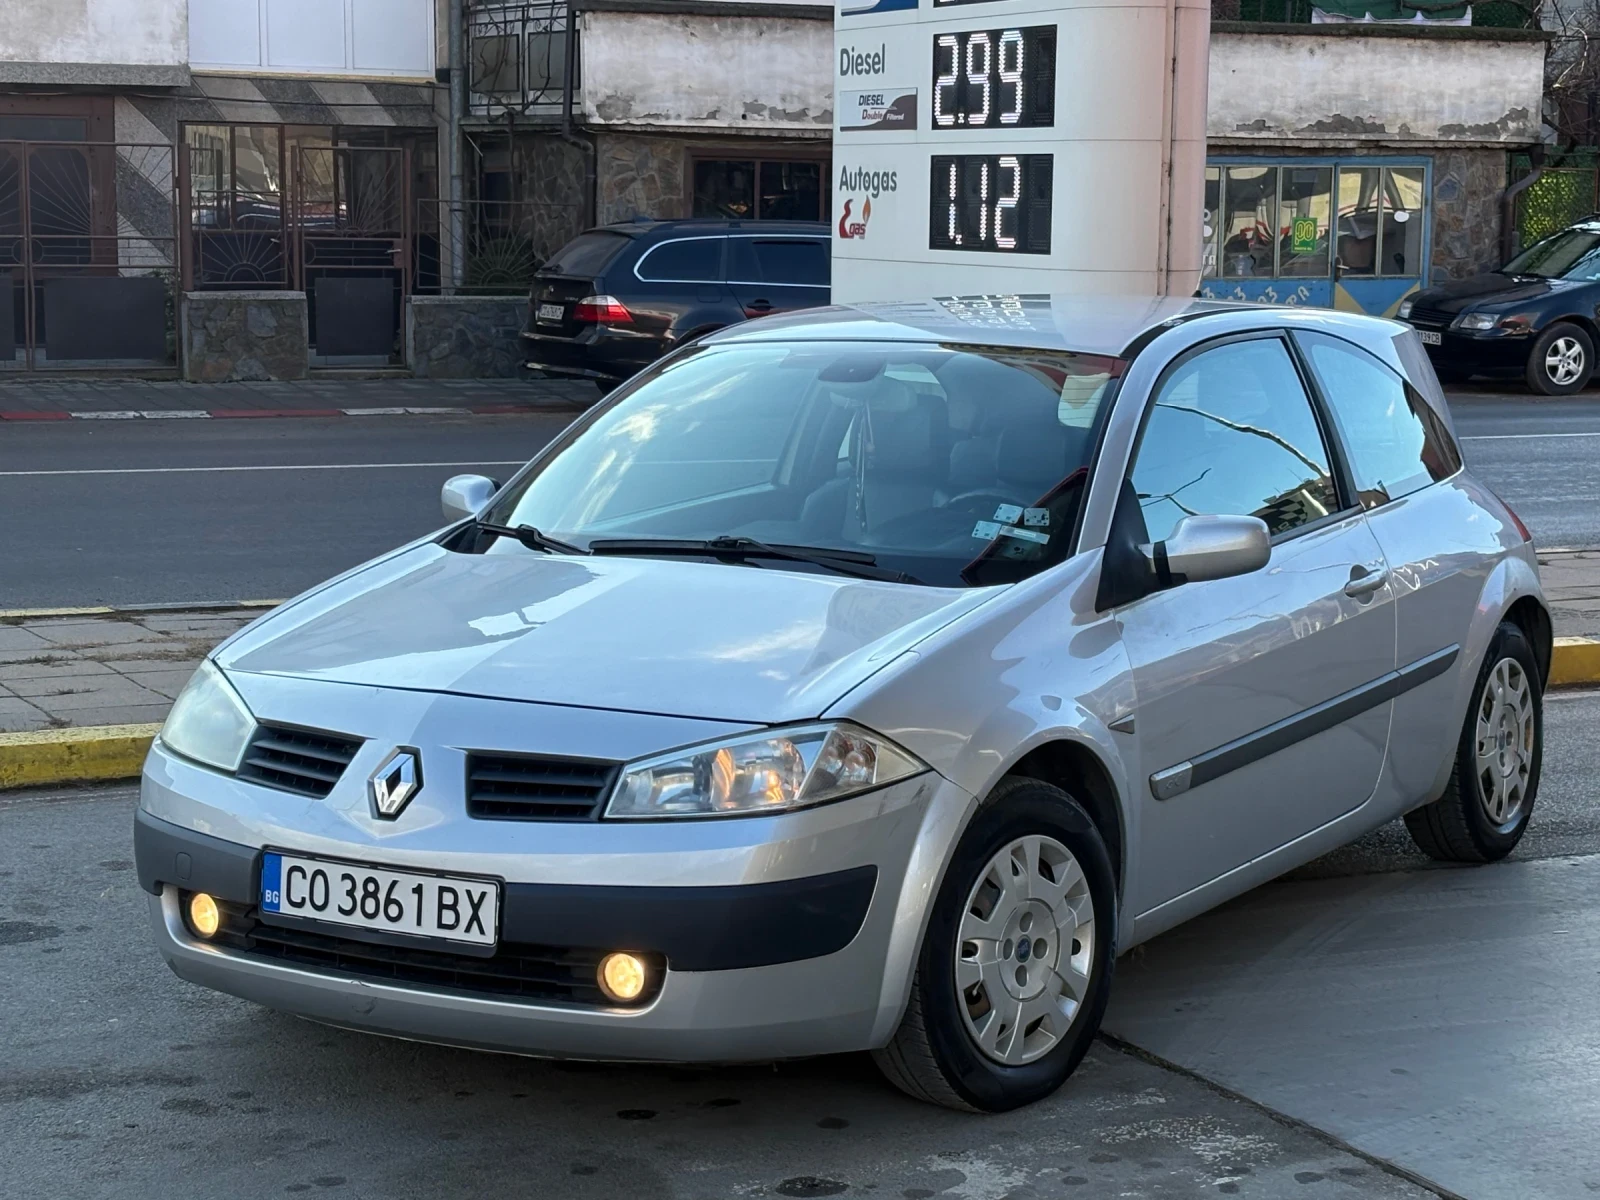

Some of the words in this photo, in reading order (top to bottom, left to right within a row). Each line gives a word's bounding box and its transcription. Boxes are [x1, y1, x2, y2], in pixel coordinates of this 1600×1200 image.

[840, 43, 885, 76] Diesel
[935, 30, 1023, 125] 2.99
[858, 94, 885, 106] DIESEL
[862, 109, 883, 120] Double
[839, 165, 897, 199] Autogas
[949, 157, 1021, 249] 1.12
[265, 889, 280, 904] BG
[286, 865, 330, 911] CO
[337, 873, 424, 927] 3861
[437, 885, 488, 936] BX
